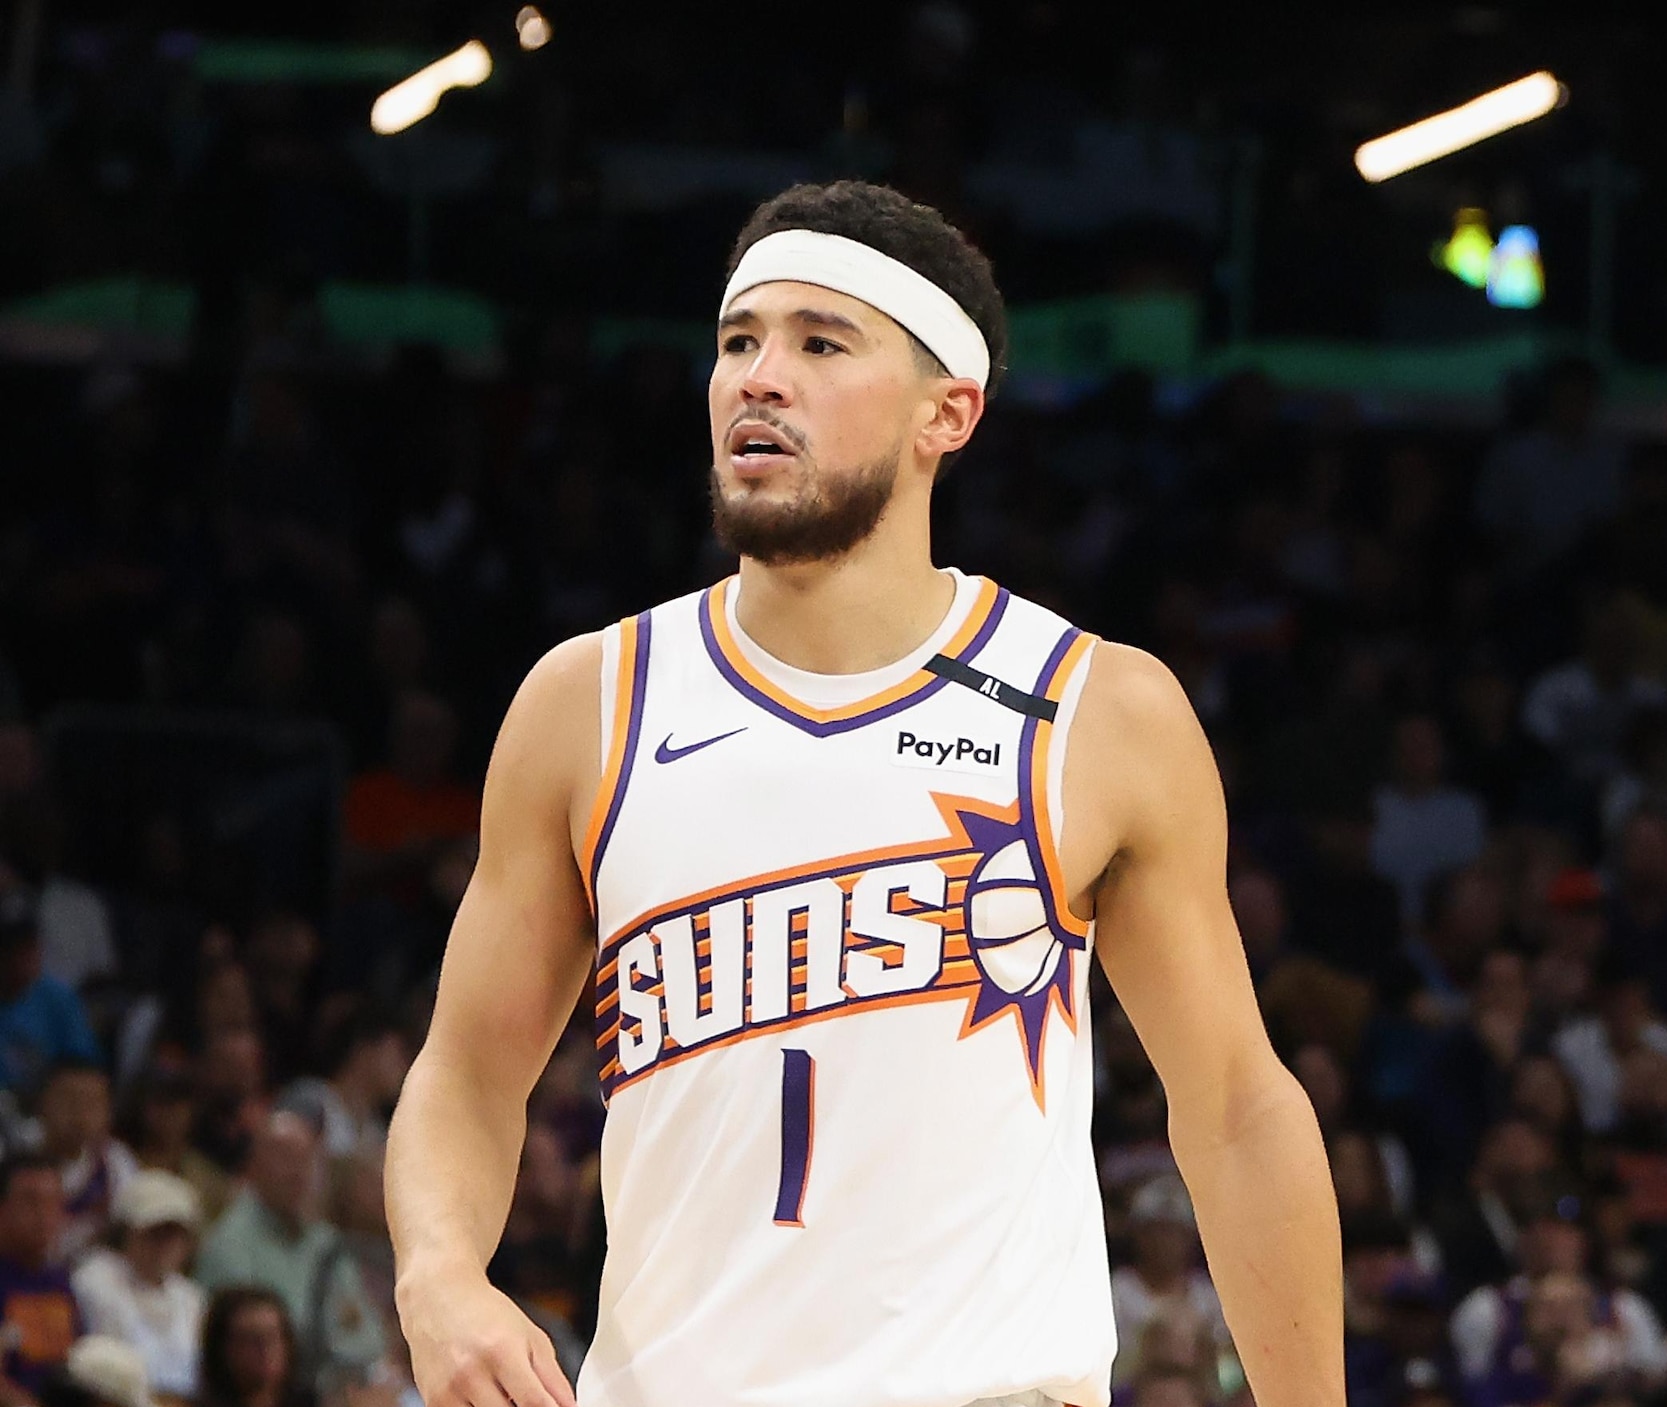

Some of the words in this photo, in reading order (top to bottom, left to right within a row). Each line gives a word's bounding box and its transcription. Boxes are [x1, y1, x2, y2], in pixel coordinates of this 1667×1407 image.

[979, 677, 1001, 699] AL
[897, 731, 1001, 766] PayPal
[772, 1048, 815, 1228] 1
